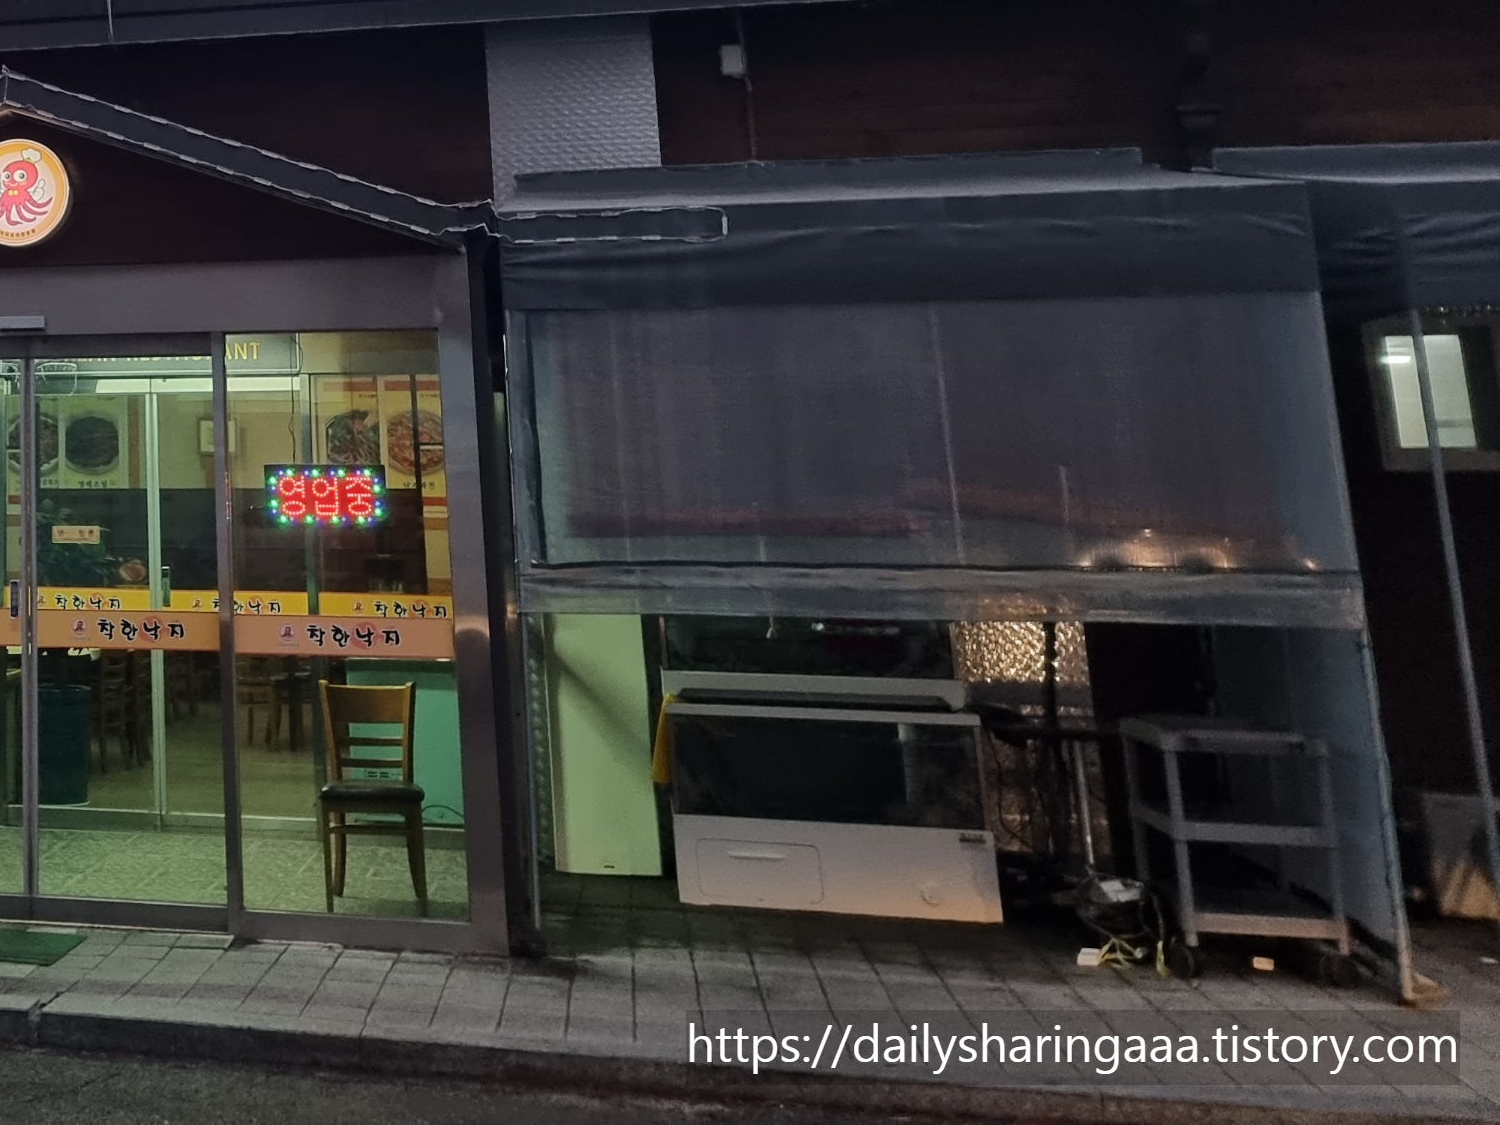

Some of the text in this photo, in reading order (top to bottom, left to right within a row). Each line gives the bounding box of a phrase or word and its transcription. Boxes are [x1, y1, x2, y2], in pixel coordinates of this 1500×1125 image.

[280, 476, 372, 515] 영업중
[55, 594, 120, 610] 착한낙지
[374, 601, 447, 617] 착한낙지
[97, 618, 185, 641] 착한낙지
[306, 624, 400, 648] 착한낙지
